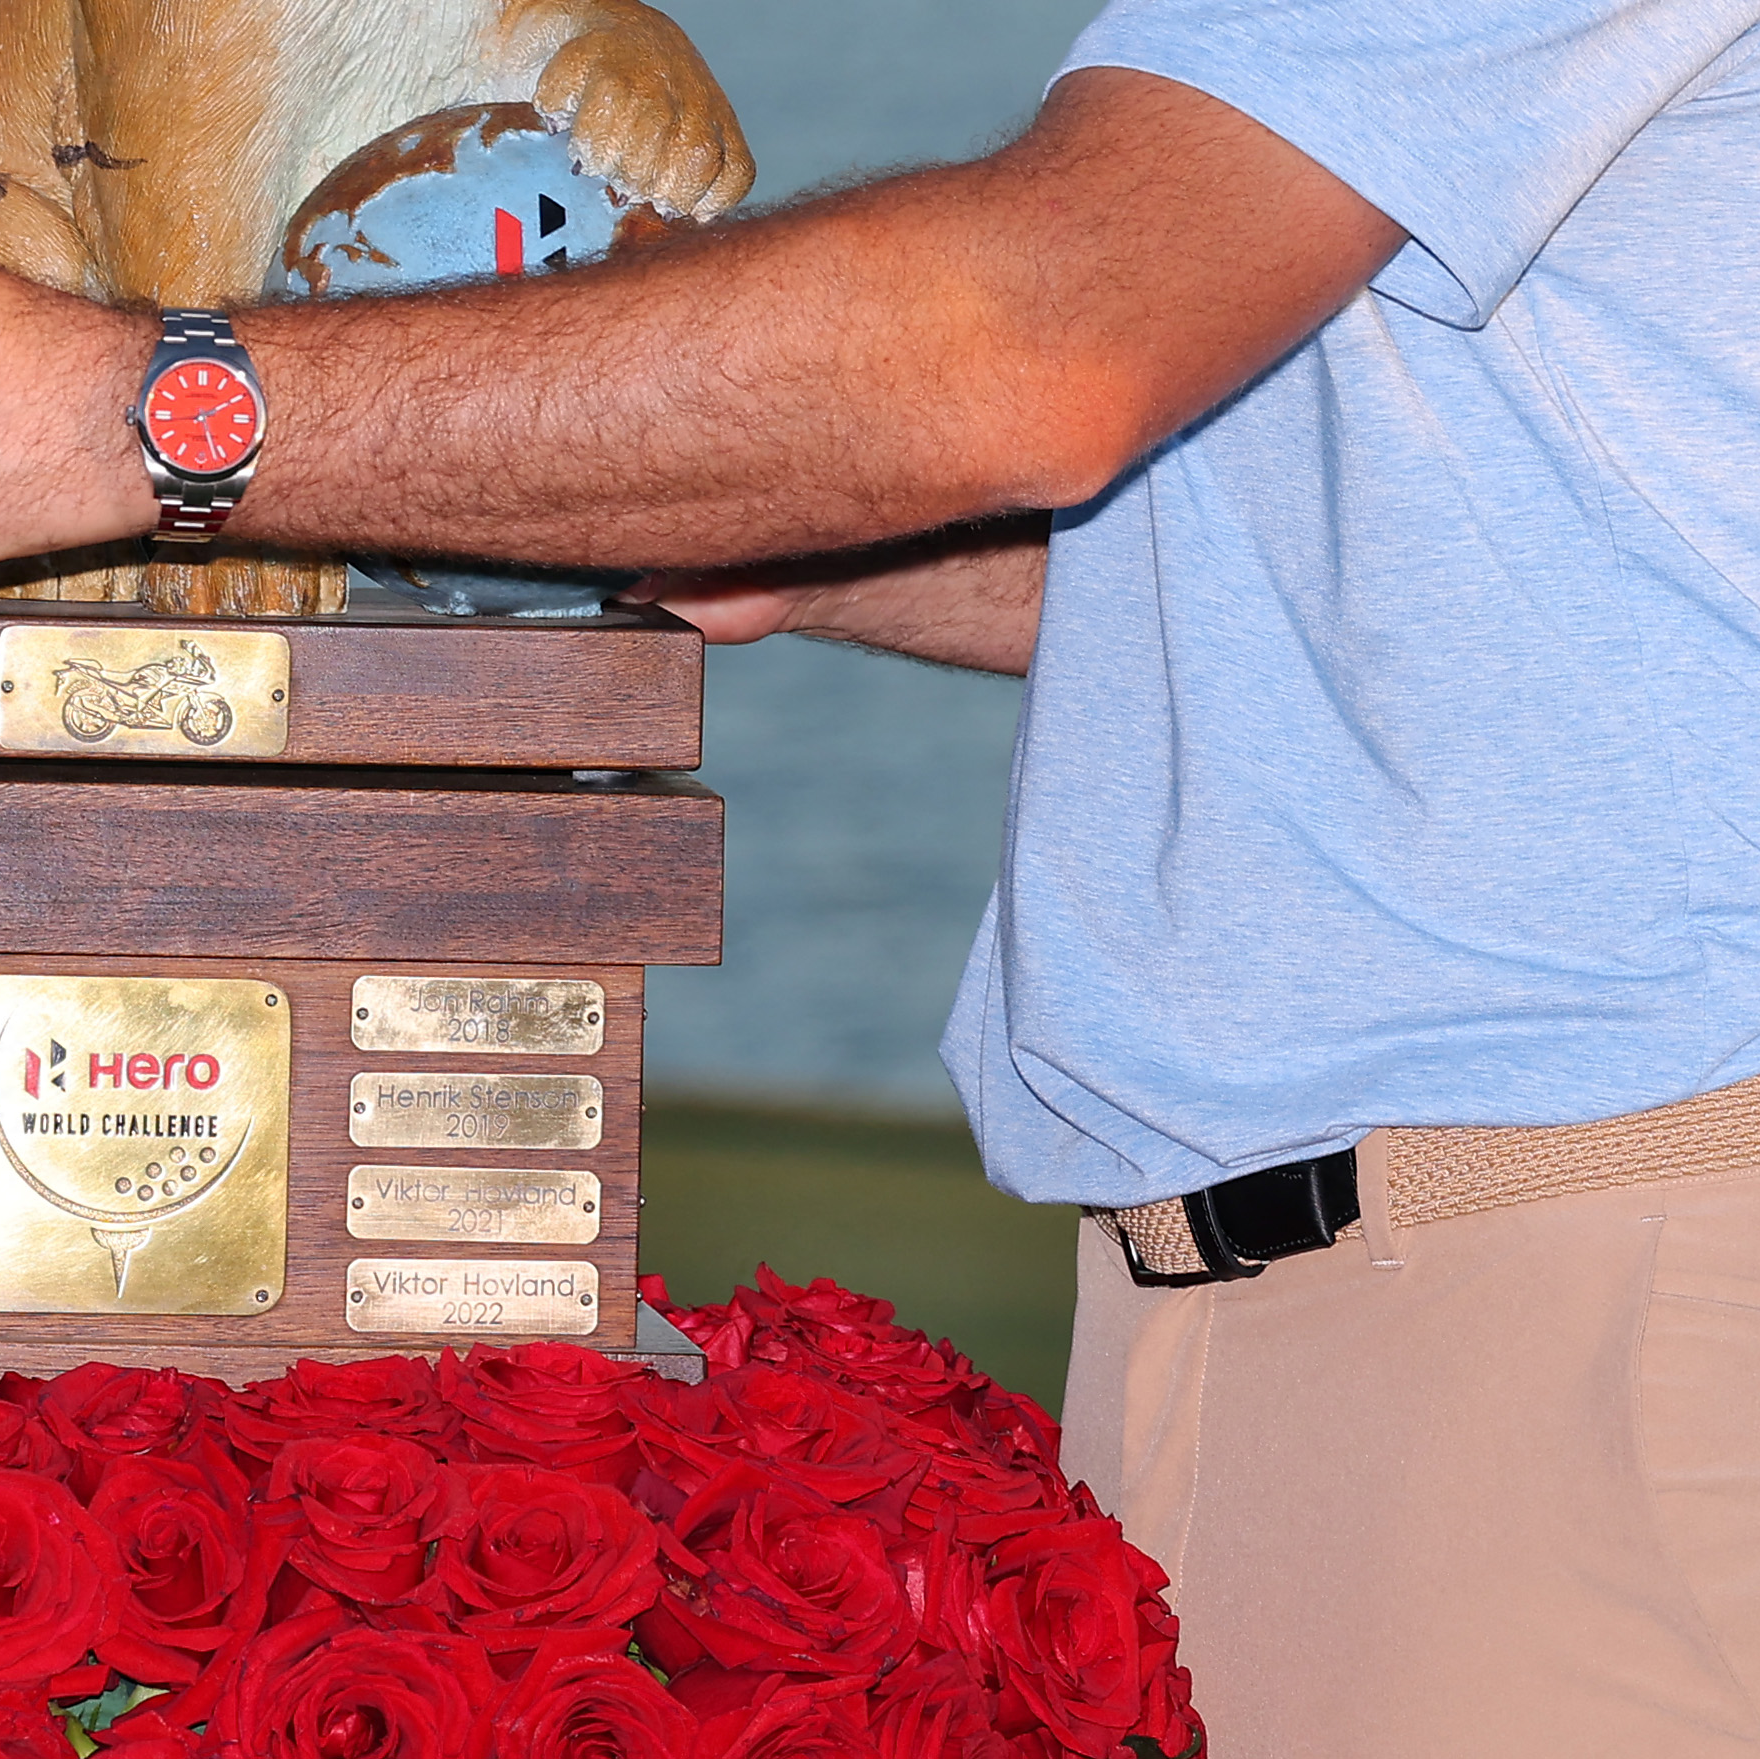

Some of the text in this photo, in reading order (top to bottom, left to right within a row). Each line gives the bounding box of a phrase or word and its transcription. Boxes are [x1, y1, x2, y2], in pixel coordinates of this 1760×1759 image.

[410, 990, 549, 1014] Jon Rahm
[448, 1018, 510, 1043] 2018
[89, 1052, 221, 1090] Hero
[378, 1085, 579, 1109] Henrik Stenson
[22, 1112, 218, 1138] WORLD CHALLENGE
[446, 1114, 510, 1138] 2019
[376, 1178, 577, 1206] Viktor Hovland
[448, 1209, 503, 1234] 2021
[373, 1271, 575, 1298] Viktor Hovland
[442, 1302, 503, 1326] 2022
